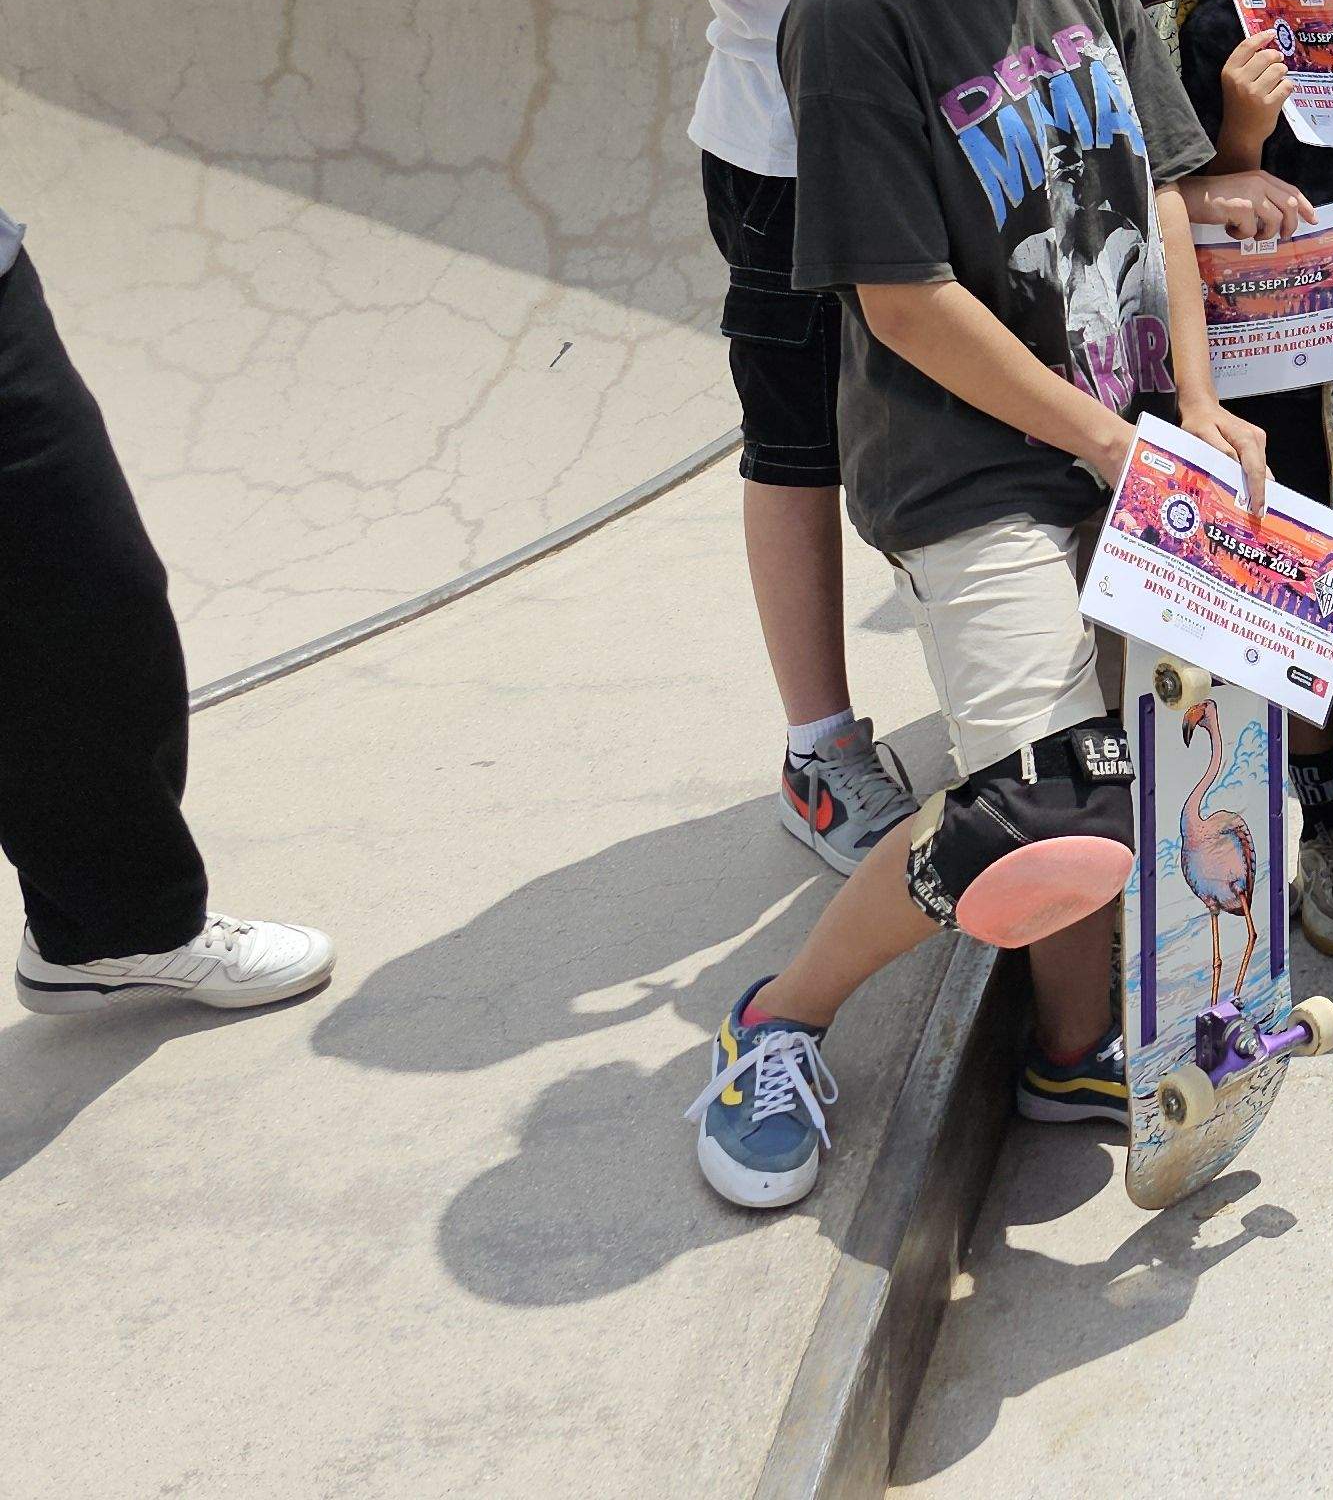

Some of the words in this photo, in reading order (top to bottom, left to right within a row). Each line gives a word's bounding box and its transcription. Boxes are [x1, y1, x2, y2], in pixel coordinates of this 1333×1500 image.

[938, 24, 1095, 136] DEAR
[1220, 280, 1256, 295] 13-15
[1258, 276, 1291, 292] SEPT.
[1293, 271, 1323, 288] 2024
[1208, 335, 1245, 348] EXTRA
[1248, 332, 1264, 344] DE
[1266, 330, 1281, 341] LA
[1284, 324, 1317, 338] LLIGA
[1221, 344, 1270, 361] EXTREM
[1207, 525, 1237, 551] 13-15
[1237, 542, 1268, 566] SEPT.
[1269, 557, 1299, 580] 2024
[1102, 542, 1176, 583] COMPETICIÓ
[1176, 576, 1212, 603] EXTRA
[1213, 595, 1229, 611] DE
[1229, 604, 1243, 619] LA
[1244, 611, 1277, 634] LLIGA
[1277, 627, 1315, 651] SKATE
[1143, 578, 1173, 600] DINS
[1186, 598, 1230, 630] EXTREM
[1230, 622, 1296, 660] BARCELONA
